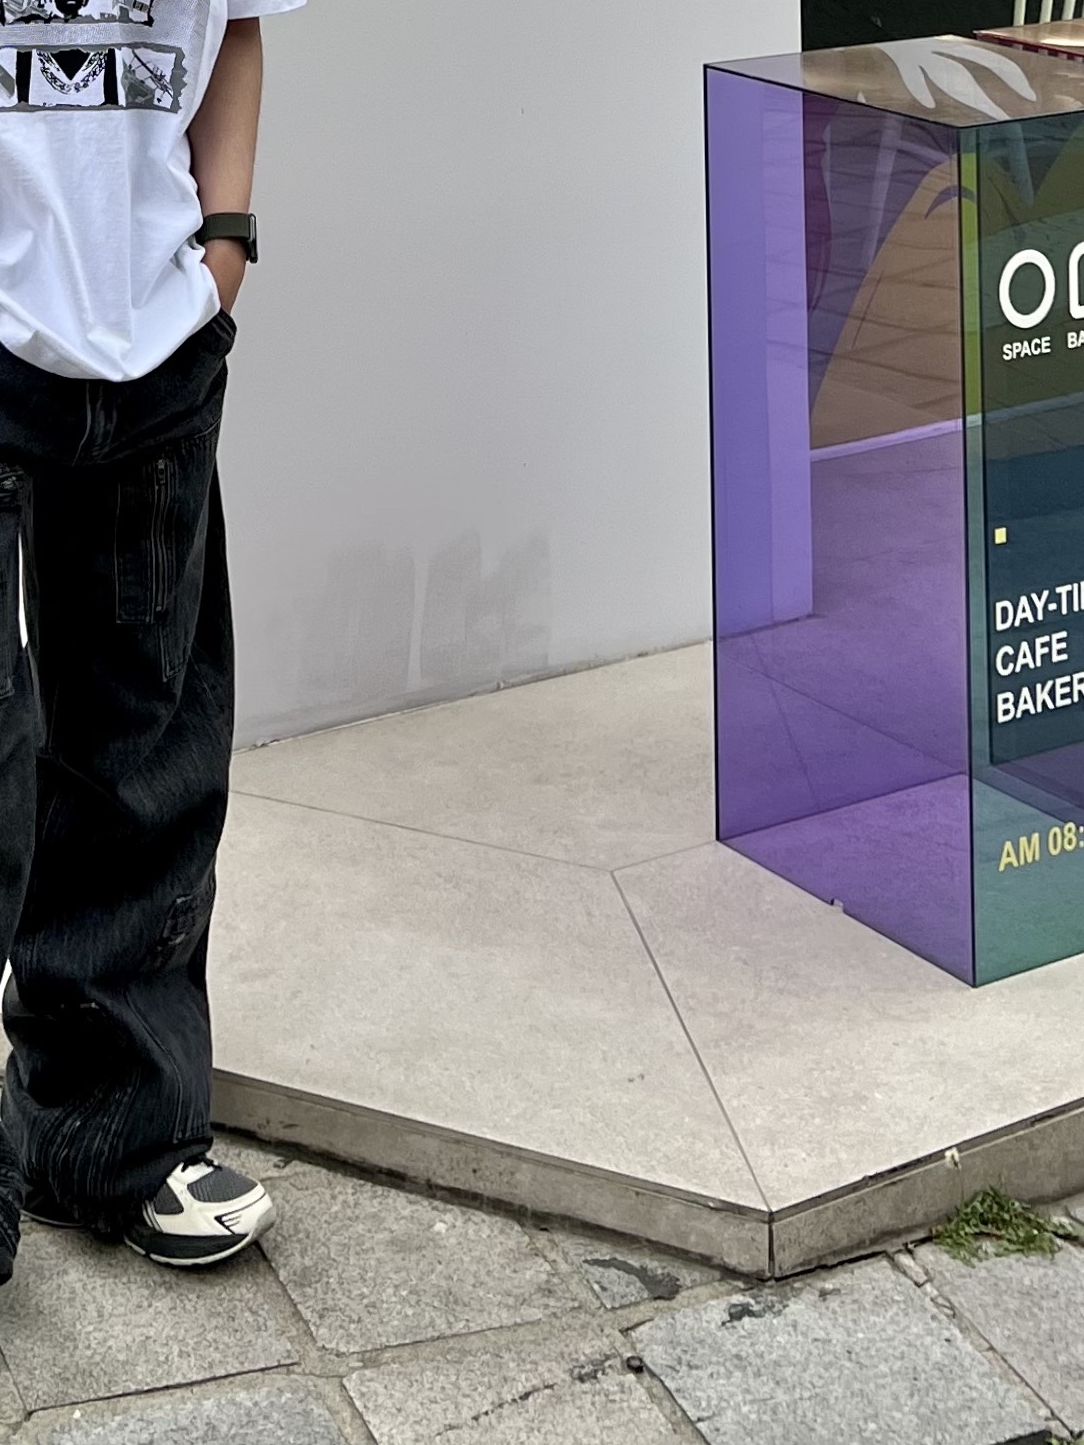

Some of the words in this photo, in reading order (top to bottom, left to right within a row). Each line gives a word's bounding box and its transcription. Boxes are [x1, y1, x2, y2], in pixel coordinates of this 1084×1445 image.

[1002, 336, 1052, 361] SPACE
[995, 580, 1084, 632] DAY-TI
[995, 630, 1069, 677] CAFE
[998, 832, 1041, 872] AM
